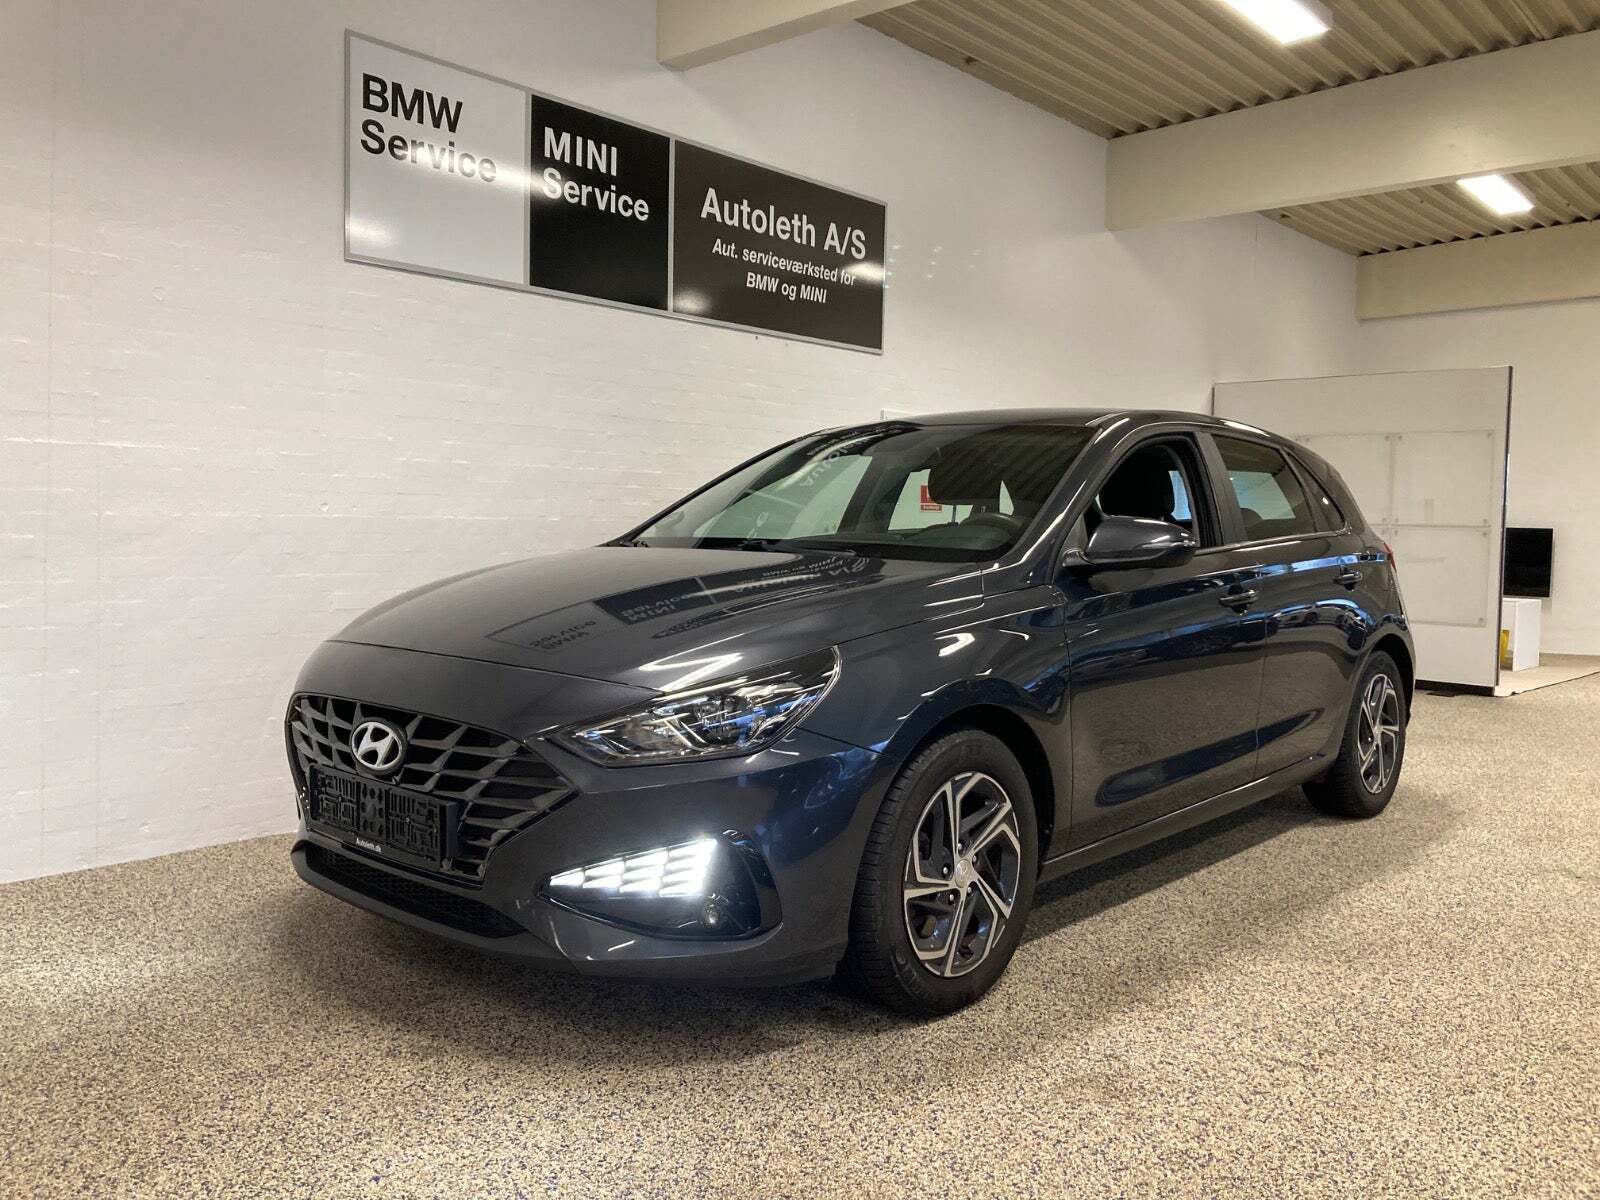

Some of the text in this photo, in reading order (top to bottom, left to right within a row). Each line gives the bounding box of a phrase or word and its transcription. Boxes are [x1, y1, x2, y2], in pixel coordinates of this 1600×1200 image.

[362, 72, 464, 134] BMW
[360, 118, 497, 183] Service
[544, 126, 618, 177] MINI
[543, 167, 649, 222] Service
[700, 187, 866, 260] Autoleth A/S
[712, 238, 857, 286] Aut. serviceværksted for
[746, 271, 828, 304] BMW og MINI
